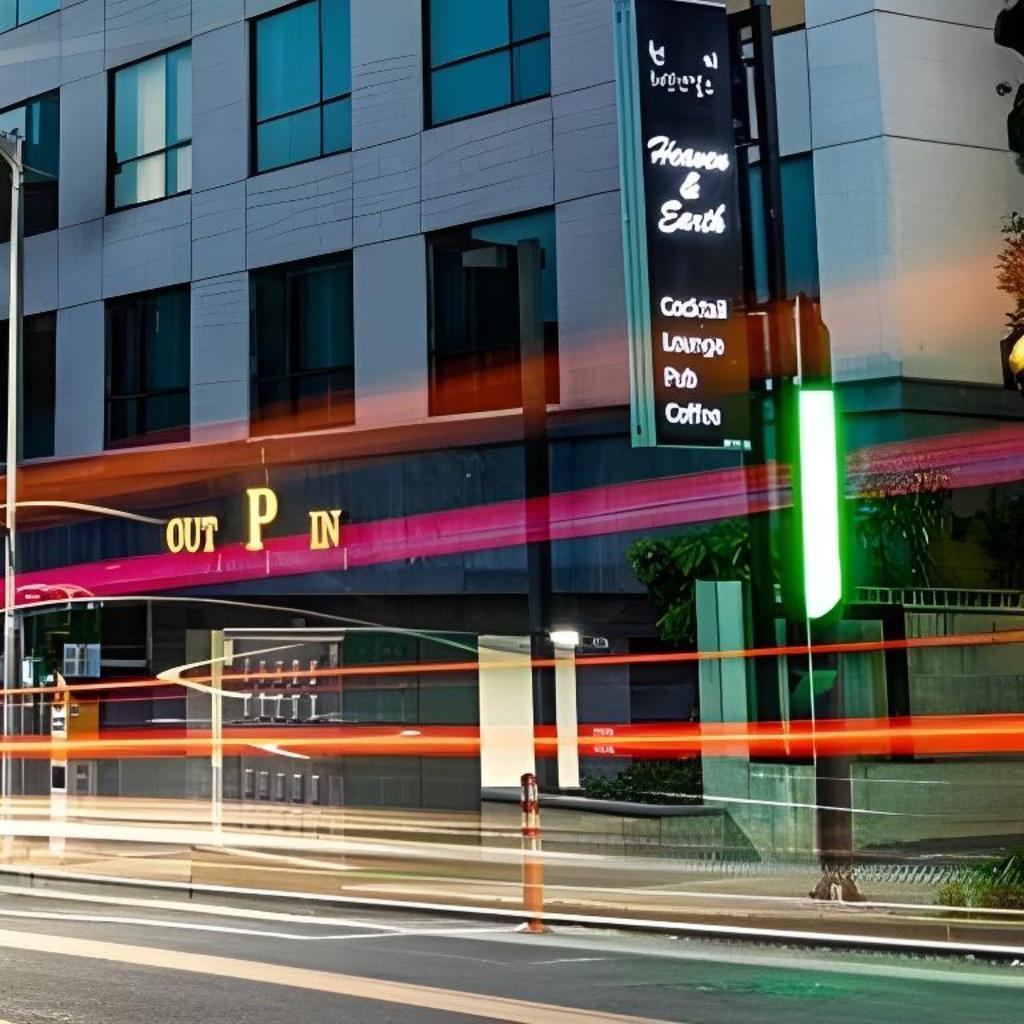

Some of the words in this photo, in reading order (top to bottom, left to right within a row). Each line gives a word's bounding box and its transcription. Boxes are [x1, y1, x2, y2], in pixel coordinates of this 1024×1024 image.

[658, 199, 726, 234] Earth
[166, 516, 218, 553] OUT
[245, 487, 278, 551] P
[309, 510, 342, 550] IN
